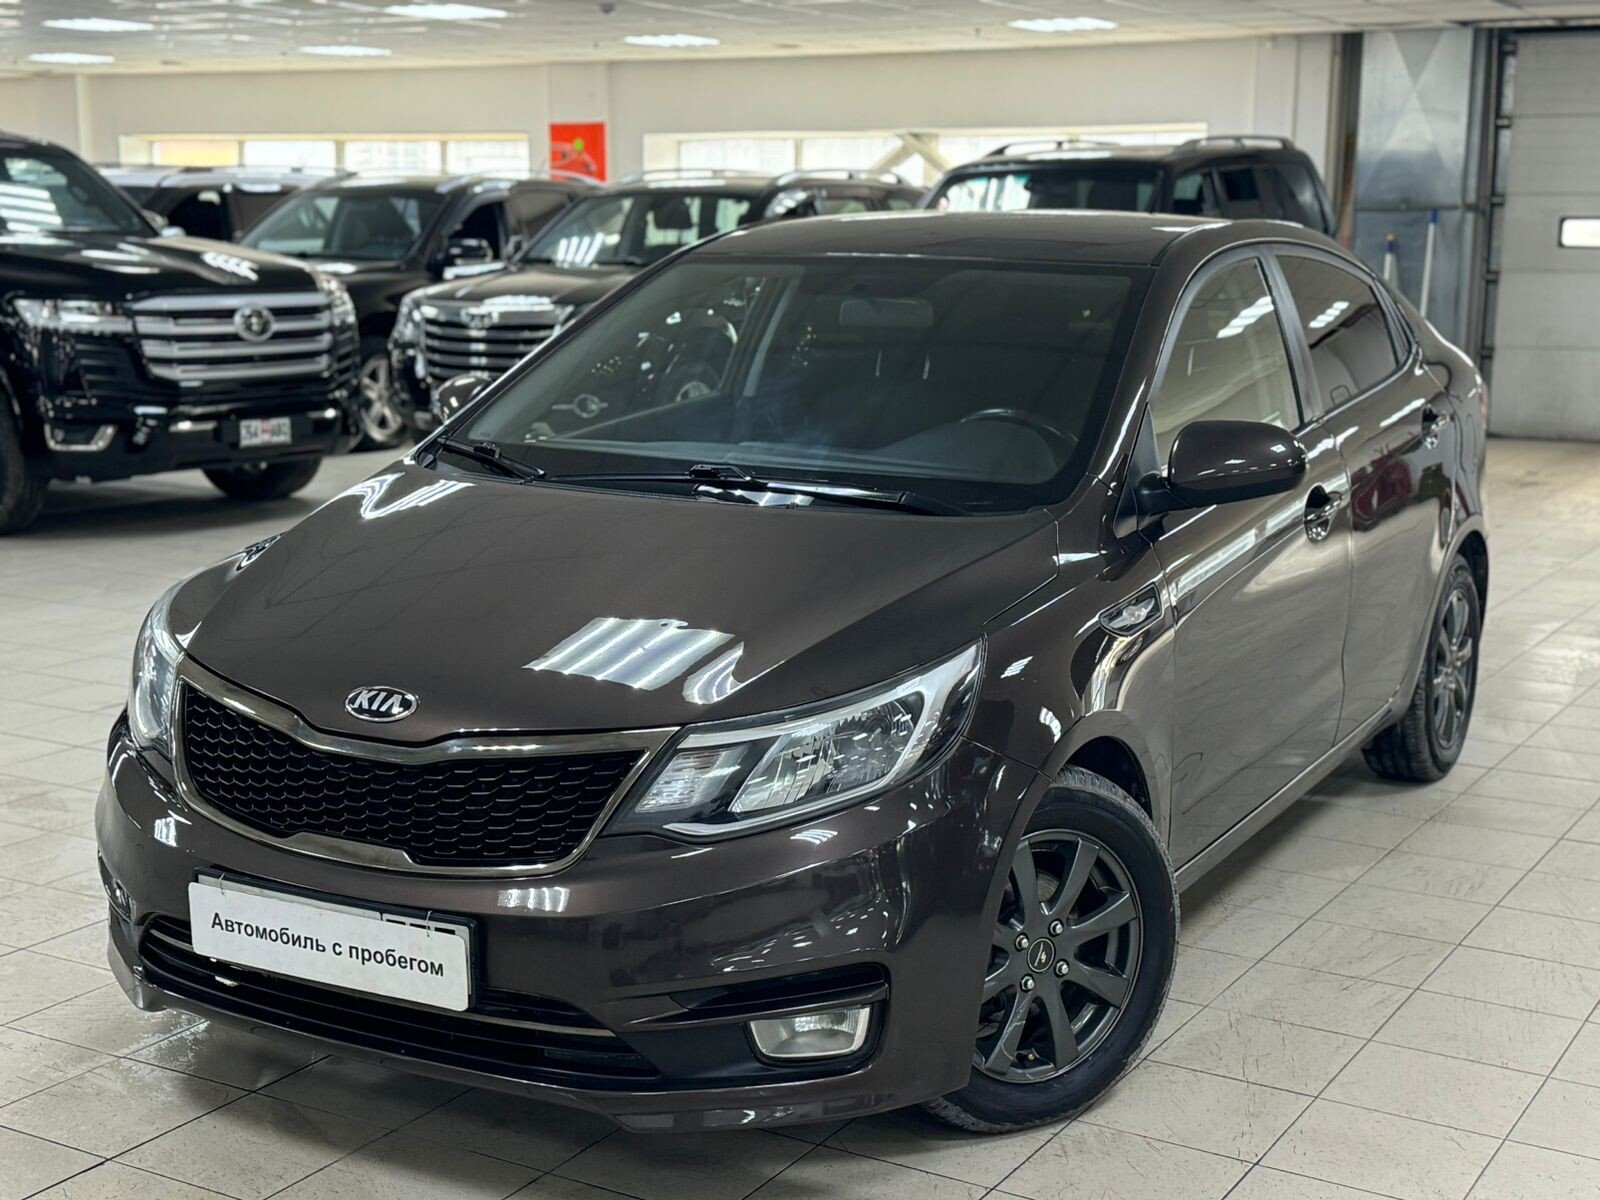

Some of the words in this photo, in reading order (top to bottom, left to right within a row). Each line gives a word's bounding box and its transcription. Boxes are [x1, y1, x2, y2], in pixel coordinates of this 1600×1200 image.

[350, 689, 404, 714] KIA
[211, 912, 326, 953] Автомобиль
[332, 943, 343, 956] с
[348, 945, 445, 977] пробегом
